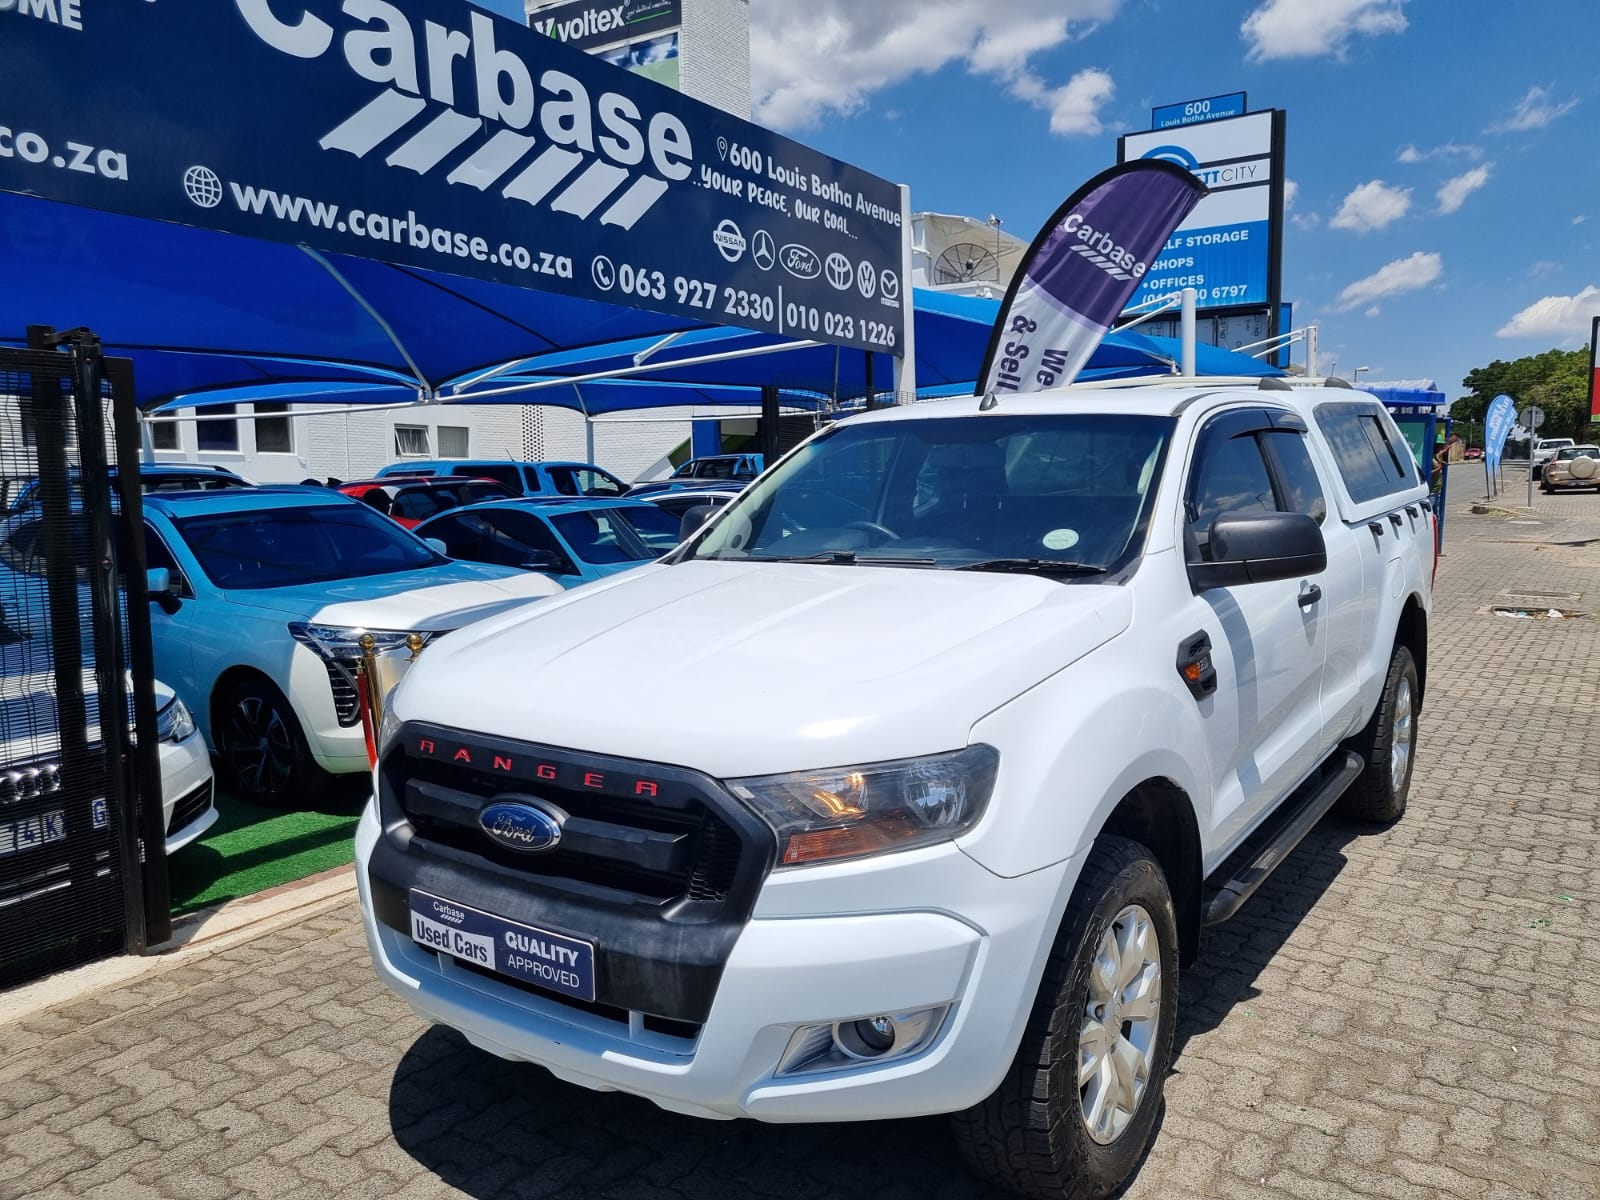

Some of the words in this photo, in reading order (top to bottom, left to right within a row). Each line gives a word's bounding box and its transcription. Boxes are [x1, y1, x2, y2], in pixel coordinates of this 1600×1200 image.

[557, 5, 625, 43] voltex
[234, 0, 693, 182] Carbase
[1185, 100, 1211, 116] 600
[1160, 116, 1180, 128] Louis
[1182, 113, 1203, 124] Botha
[1206, 109, 1235, 121] Avenue
[729, 143, 763, 175] 600
[767, 156, 808, 192] Louis
[811, 174, 852, 209] Botha
[855, 192, 902, 227] Avenue
[747, 182, 792, 218] PEACE,
[795, 198, 821, 224] OUR
[229, 180, 574, 279] www.carbase.co.za
[715, 232, 745, 249] NISSAN
[1063, 213, 1146, 279] Carbase
[1186, 230, 1249, 247] STORAGE
[787, 248, 814, 274] Ford
[1150, 257, 1194, 271] SHOPS
[619, 263, 667, 298] 063
[673, 276, 718, 311] 927
[724, 287, 774, 322] 2330
[1150, 275, 1205, 290] OFFICES
[1212, 285, 1248, 299] 6797
[786, 302, 819, 332] 010
[824, 311, 854, 339] 023
[859, 319, 895, 347] 1226
[1010, 315, 1038, 335] &
[996, 341, 1030, 391] Sell
[1036, 348, 1069, 387] We
[419, 738, 659, 797] RANGER
[491, 812, 535, 844] Ford
[432, 900, 466, 921] Carbase
[415, 918, 450, 950] Used
[453, 933, 488, 963] Cars
[504, 930, 580, 968] QUALITY
[507, 953, 580, 989] APPROVED
